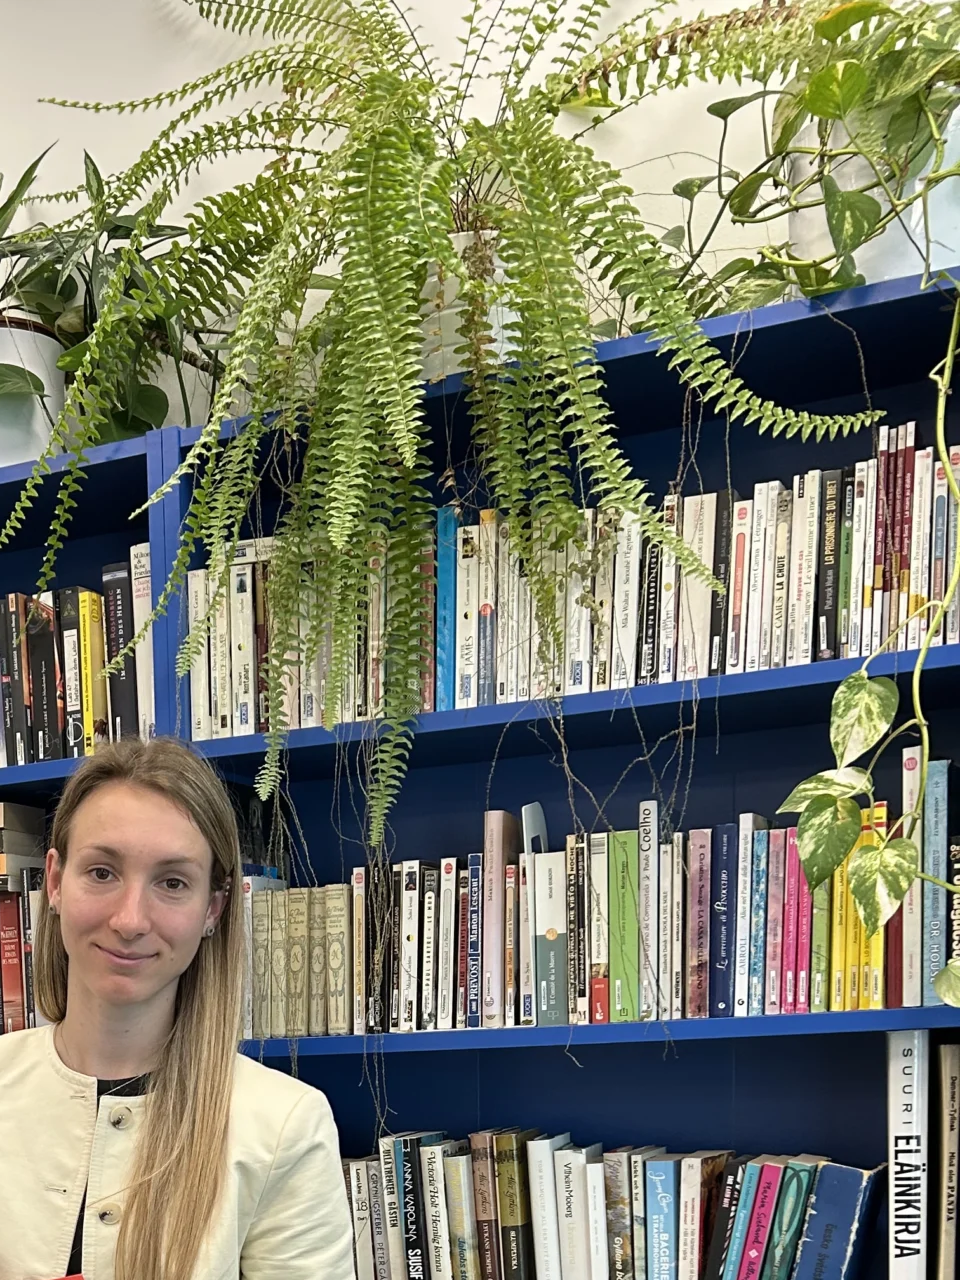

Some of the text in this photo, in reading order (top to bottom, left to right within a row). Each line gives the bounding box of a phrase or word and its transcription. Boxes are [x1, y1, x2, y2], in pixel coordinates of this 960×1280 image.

[827, 480, 836, 498] TIBET
[775, 555, 785, 629] CAMUS CHUTE
[640, 808, 651, 852] Coelho
[470, 877, 480, 942] Manon Lescaut
[470, 958, 479, 1000] PREVOST
[425, 1152, 436, 1187] Victoria
[894, 1048, 926, 1259] SUURI ELÄINKIRJA
[946, 1186, 955, 1221] PANDA
